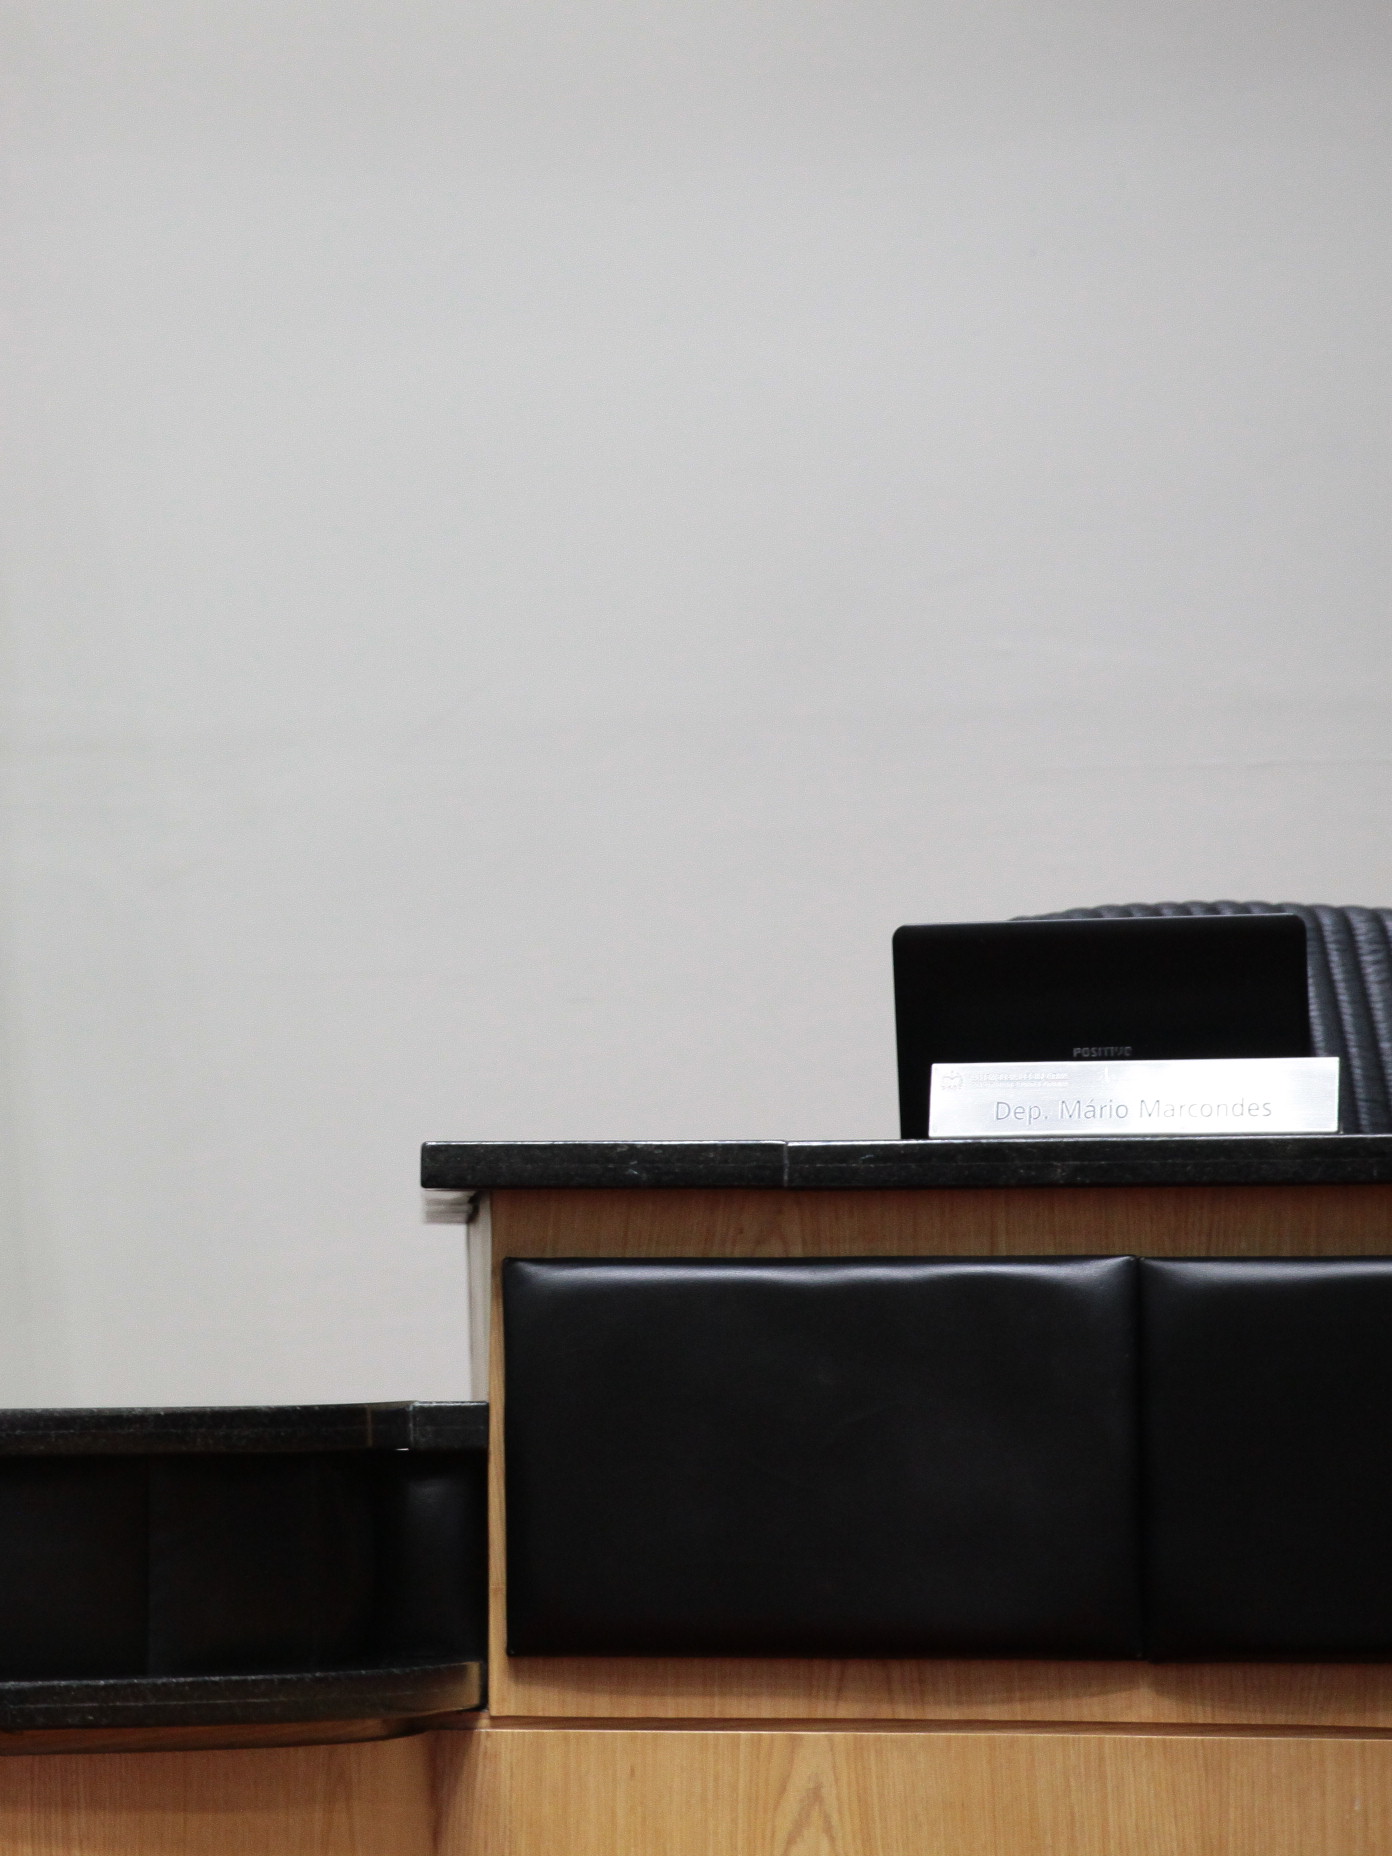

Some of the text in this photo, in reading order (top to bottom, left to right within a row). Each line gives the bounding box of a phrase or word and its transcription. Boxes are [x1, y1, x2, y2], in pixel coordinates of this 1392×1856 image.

[994, 1097, 1273, 1126] Dep. Mário Marcondes
